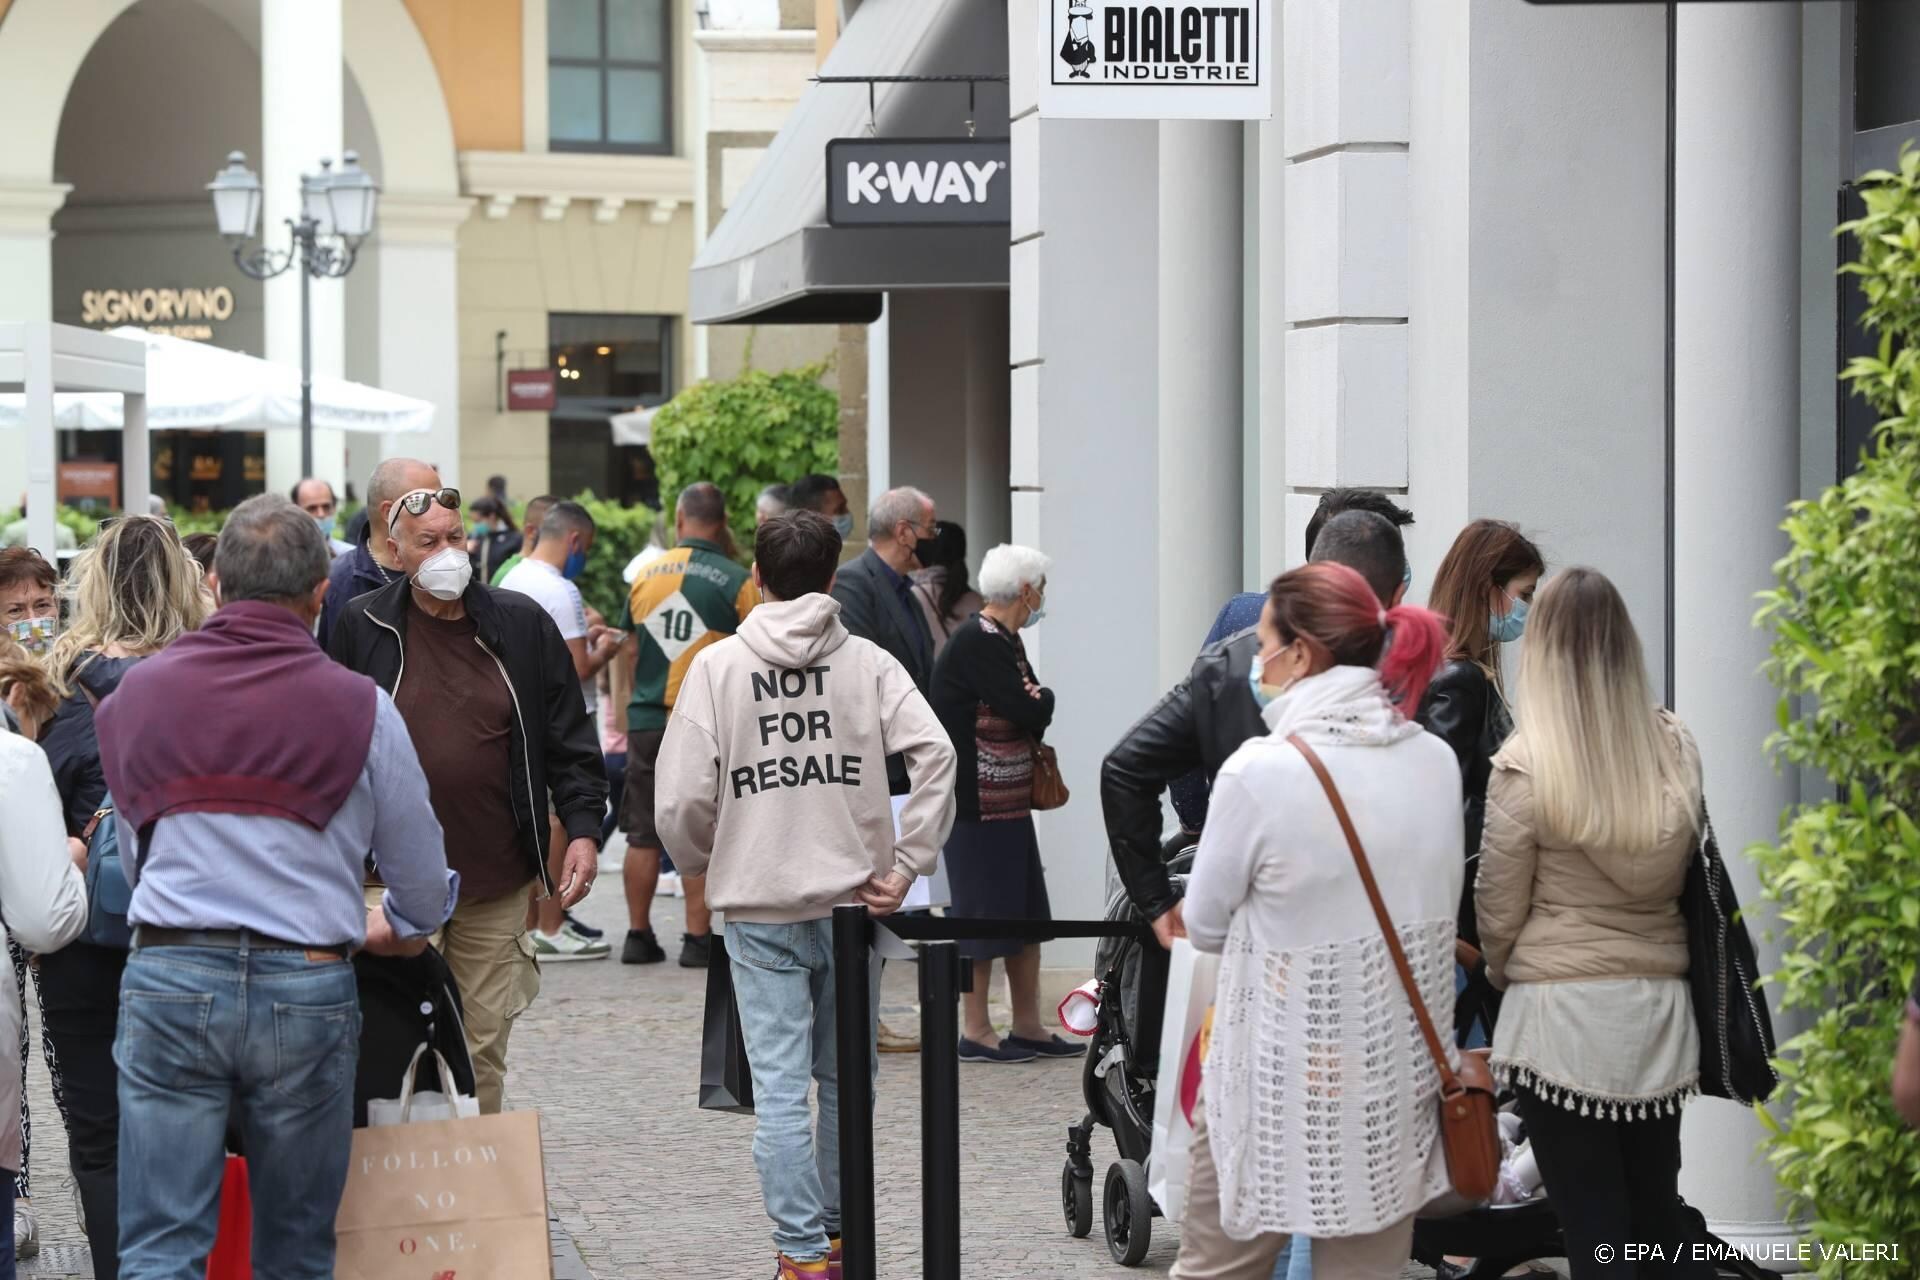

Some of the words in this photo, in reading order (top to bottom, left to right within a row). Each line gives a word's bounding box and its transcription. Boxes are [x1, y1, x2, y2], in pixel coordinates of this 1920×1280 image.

[1104, 65, 1249, 79] INDUSTRIE
[81, 286, 234, 323] SIGNORVINO
[659, 608, 693, 641] 10
[751, 666, 831, 702] NOT
[758, 710, 833, 746] FOR
[730, 753, 862, 799] RESALE
[362, 1145, 498, 1175] FOLLOW
[415, 1191, 455, 1209] NO
[399, 1232, 478, 1254] ONE.
